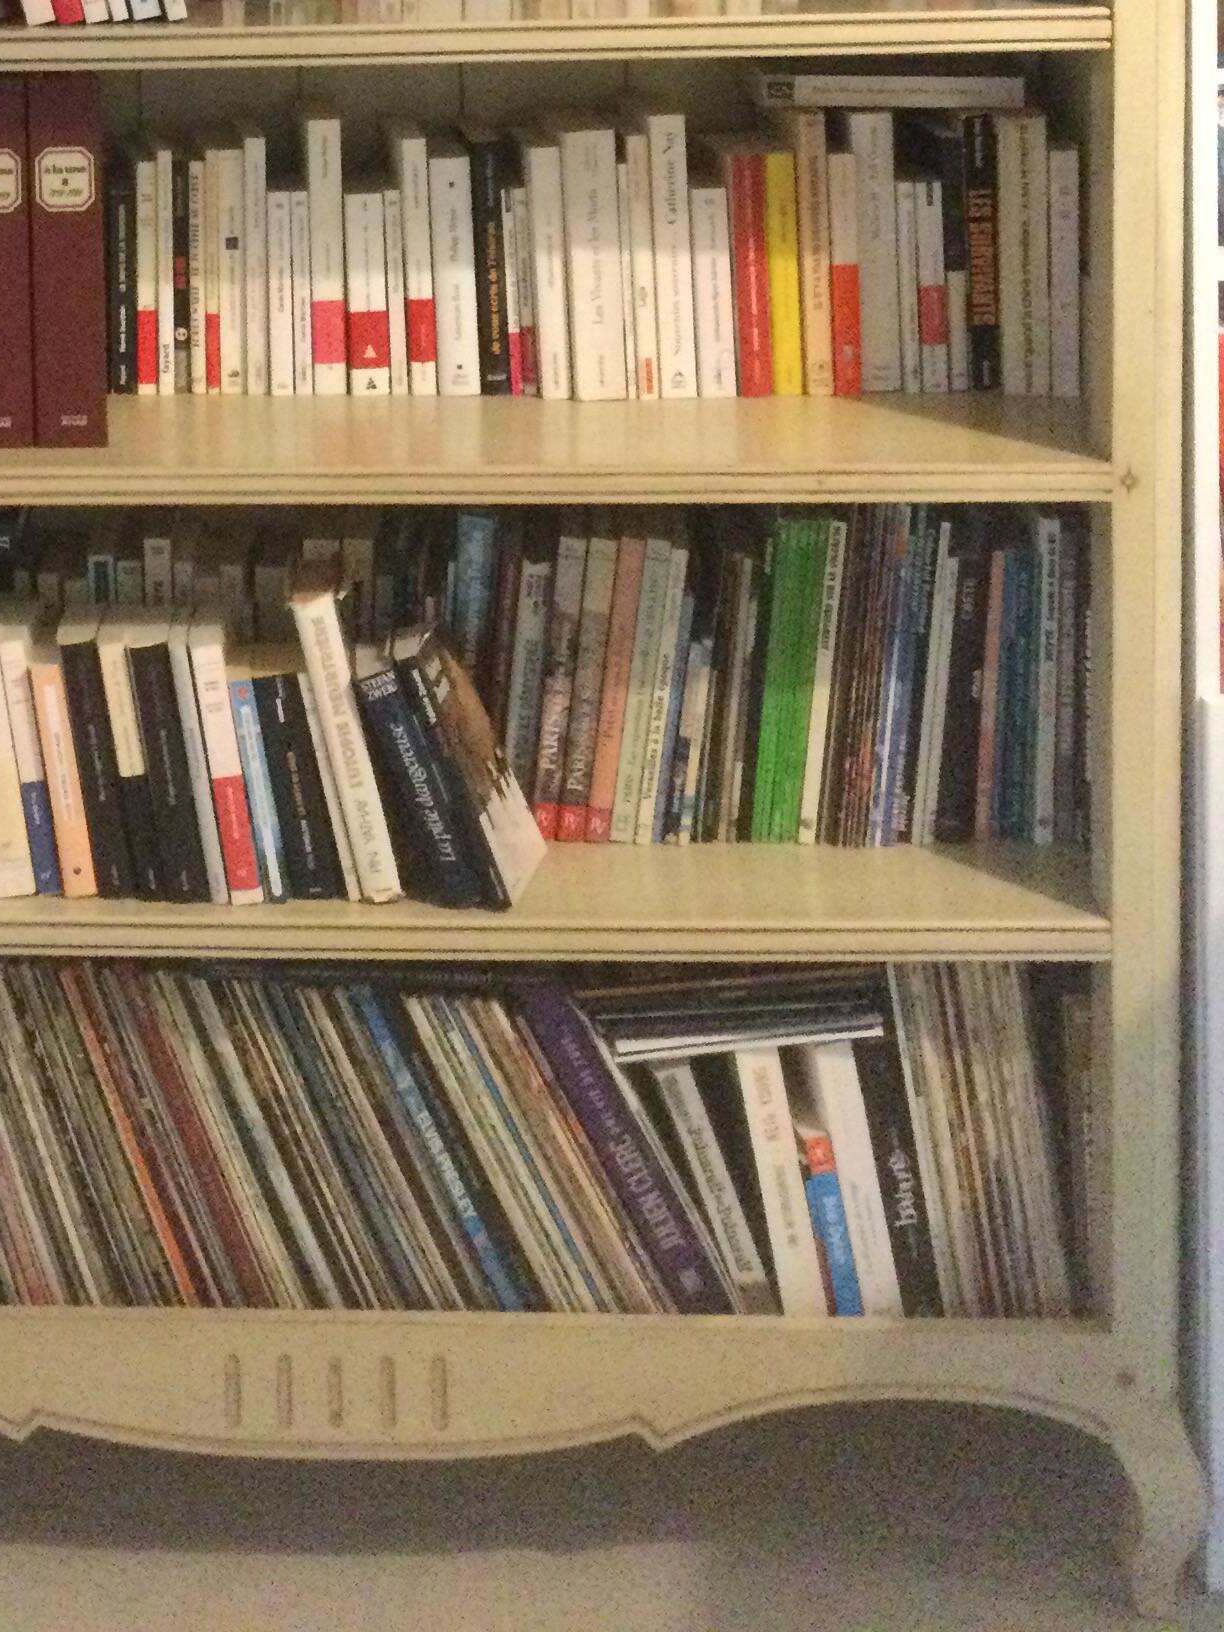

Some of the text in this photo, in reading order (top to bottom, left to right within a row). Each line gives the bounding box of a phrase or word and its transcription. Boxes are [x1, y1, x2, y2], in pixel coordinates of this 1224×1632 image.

[661, 131, 677, 154] Nay
[664, 159, 679, 225] Catherine
[969, 188, 992, 218] LES
[969, 221, 995, 327] SURVIVANTS
[361, 672, 396, 693] STEFAN
[387, 716, 438, 811] dangereuse
[538, 713, 564, 771] PARIS
[433, 839, 458, 865] La
[435, 1152, 478, 1222] PRESLEY
[602, 1130, 691, 1258] JULIEN CLERC
